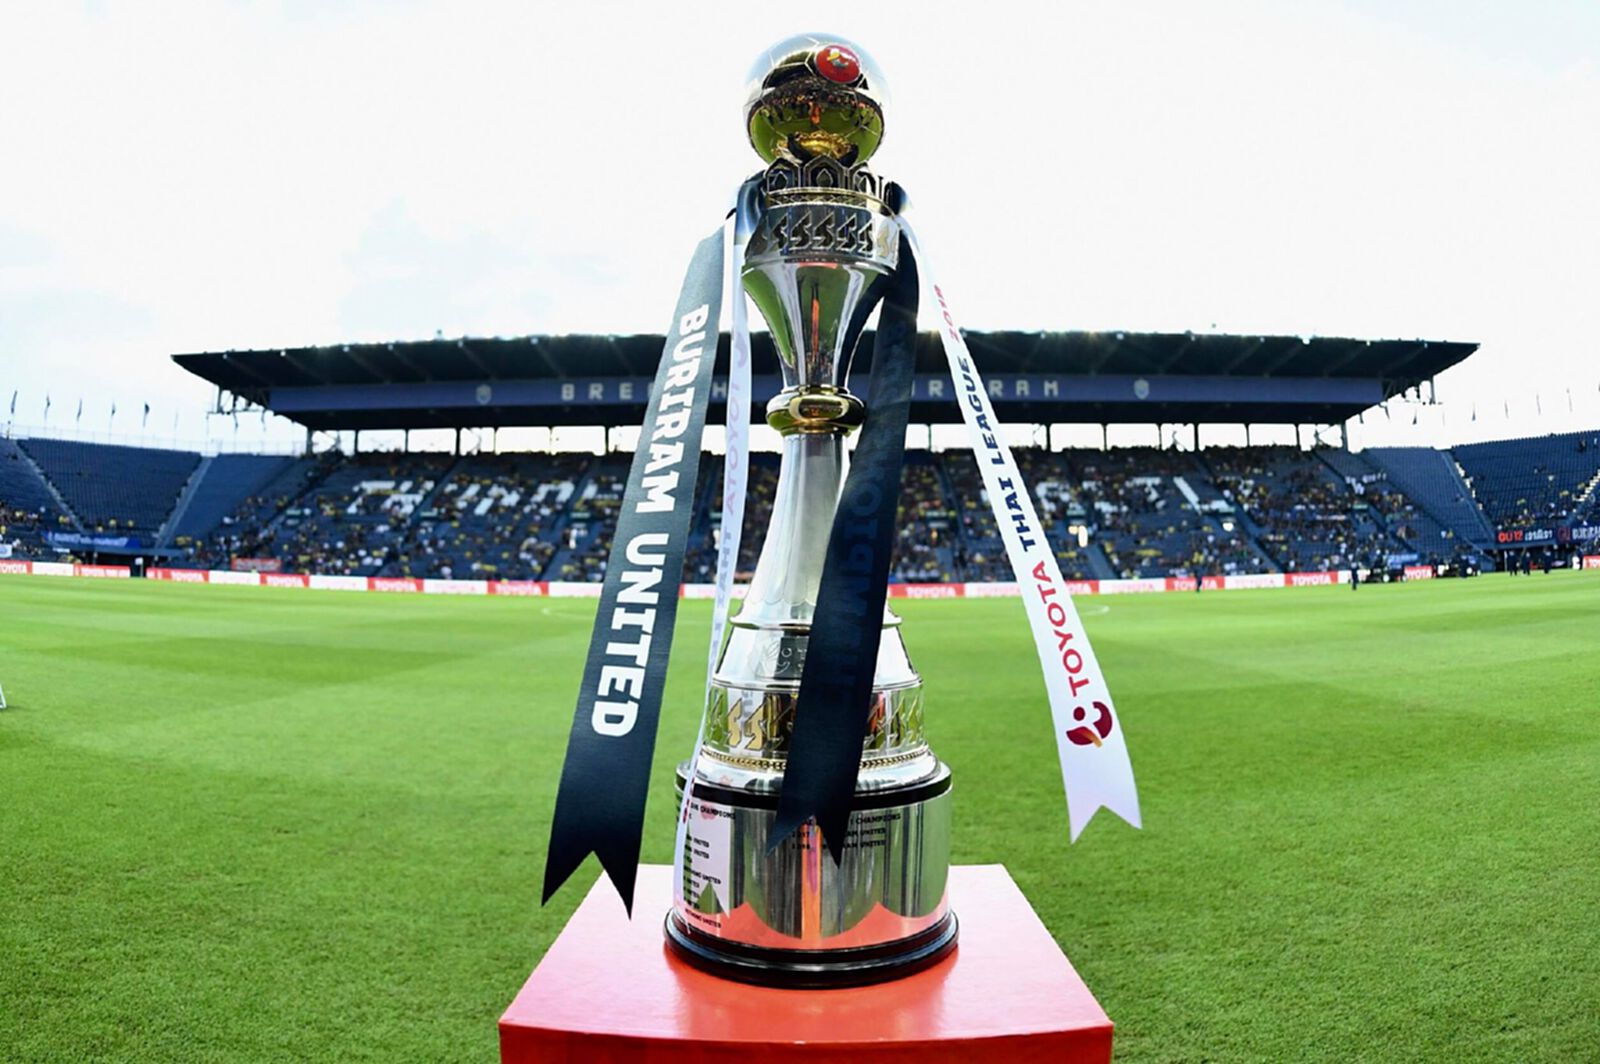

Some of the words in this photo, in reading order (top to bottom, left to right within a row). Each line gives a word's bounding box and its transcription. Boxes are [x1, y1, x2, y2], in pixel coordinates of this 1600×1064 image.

[635, 304, 710, 514] BURIRAM
[911, 379, 1059, 397] RRAM
[957, 356, 1005, 465] LEAGUE
[998, 477, 1036, 552] THAI
[906, 586, 957, 598] TOYOTA
[1292, 574, 1331, 587] TOYOTA
[591, 533, 670, 737] UNITED
[1032, 560, 1090, 697] TOYOTA
